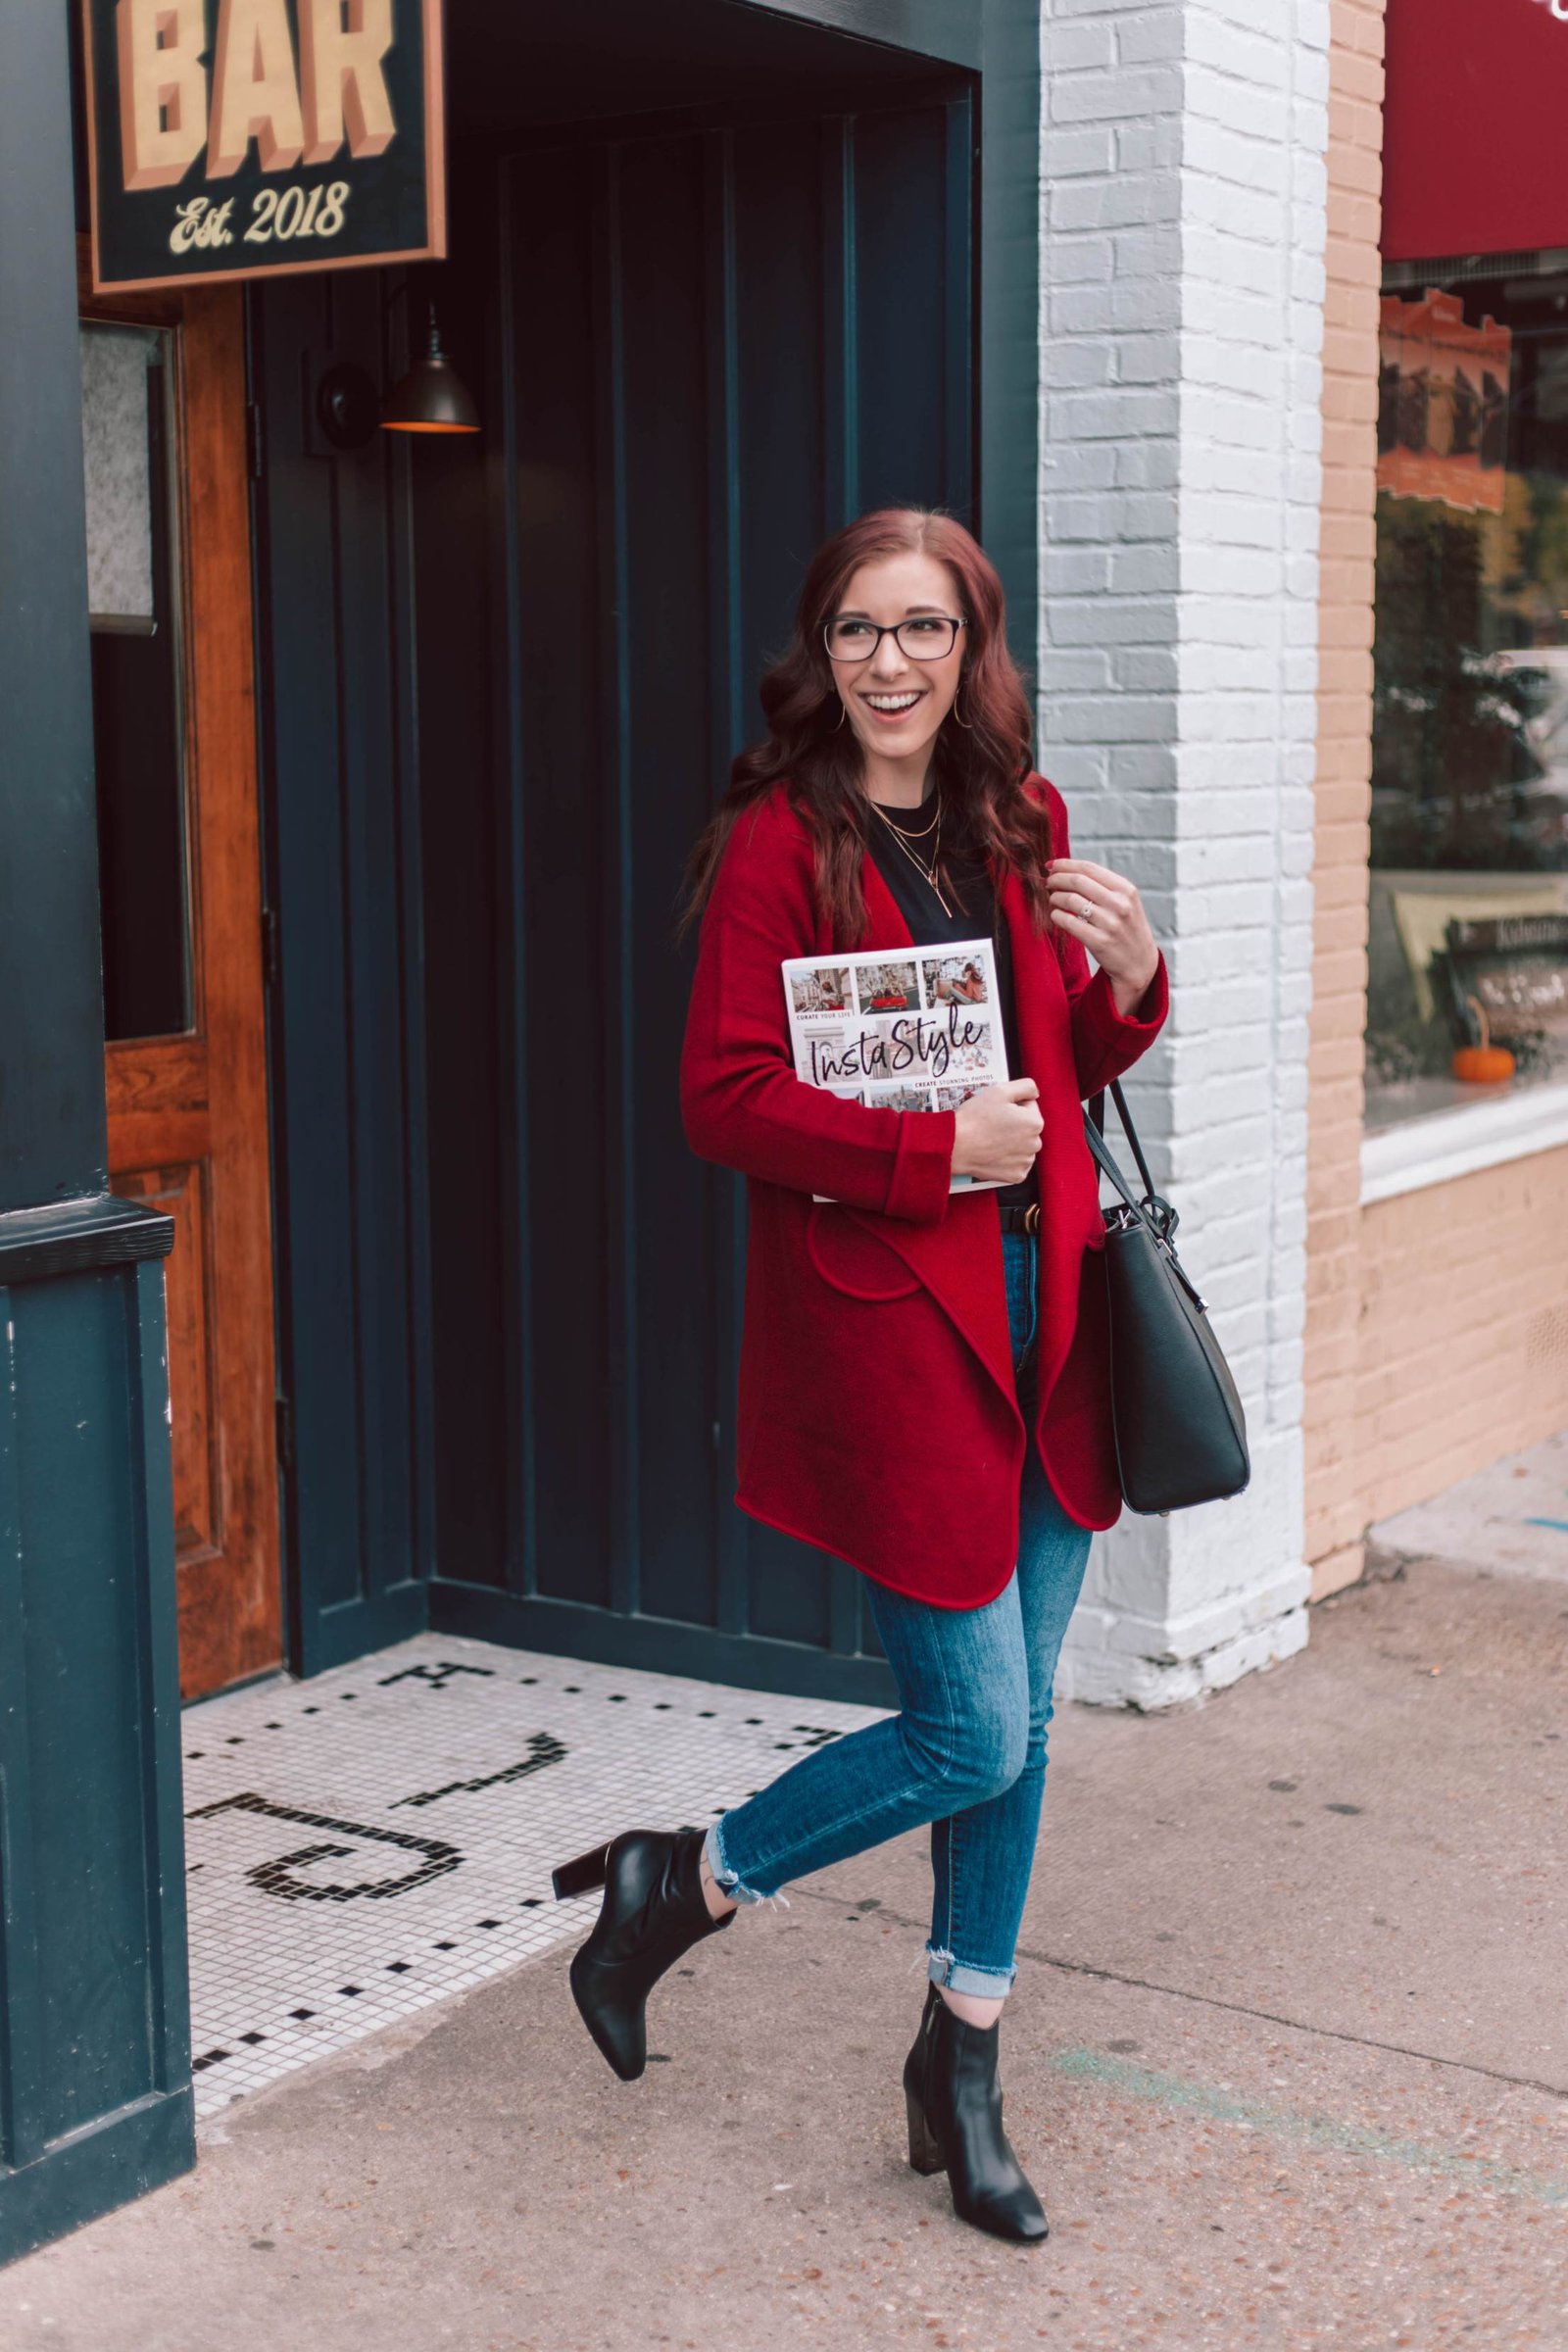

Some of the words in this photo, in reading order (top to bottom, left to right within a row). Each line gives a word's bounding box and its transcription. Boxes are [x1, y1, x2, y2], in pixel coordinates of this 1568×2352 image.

[116, 0, 396, 191] BAR
[169, 196, 234, 254] Est.
[244, 181, 350, 244] 2018
[939, 1076, 969, 1085] STUNNING
[971, 1073, 994, 1082] PHOTOS
